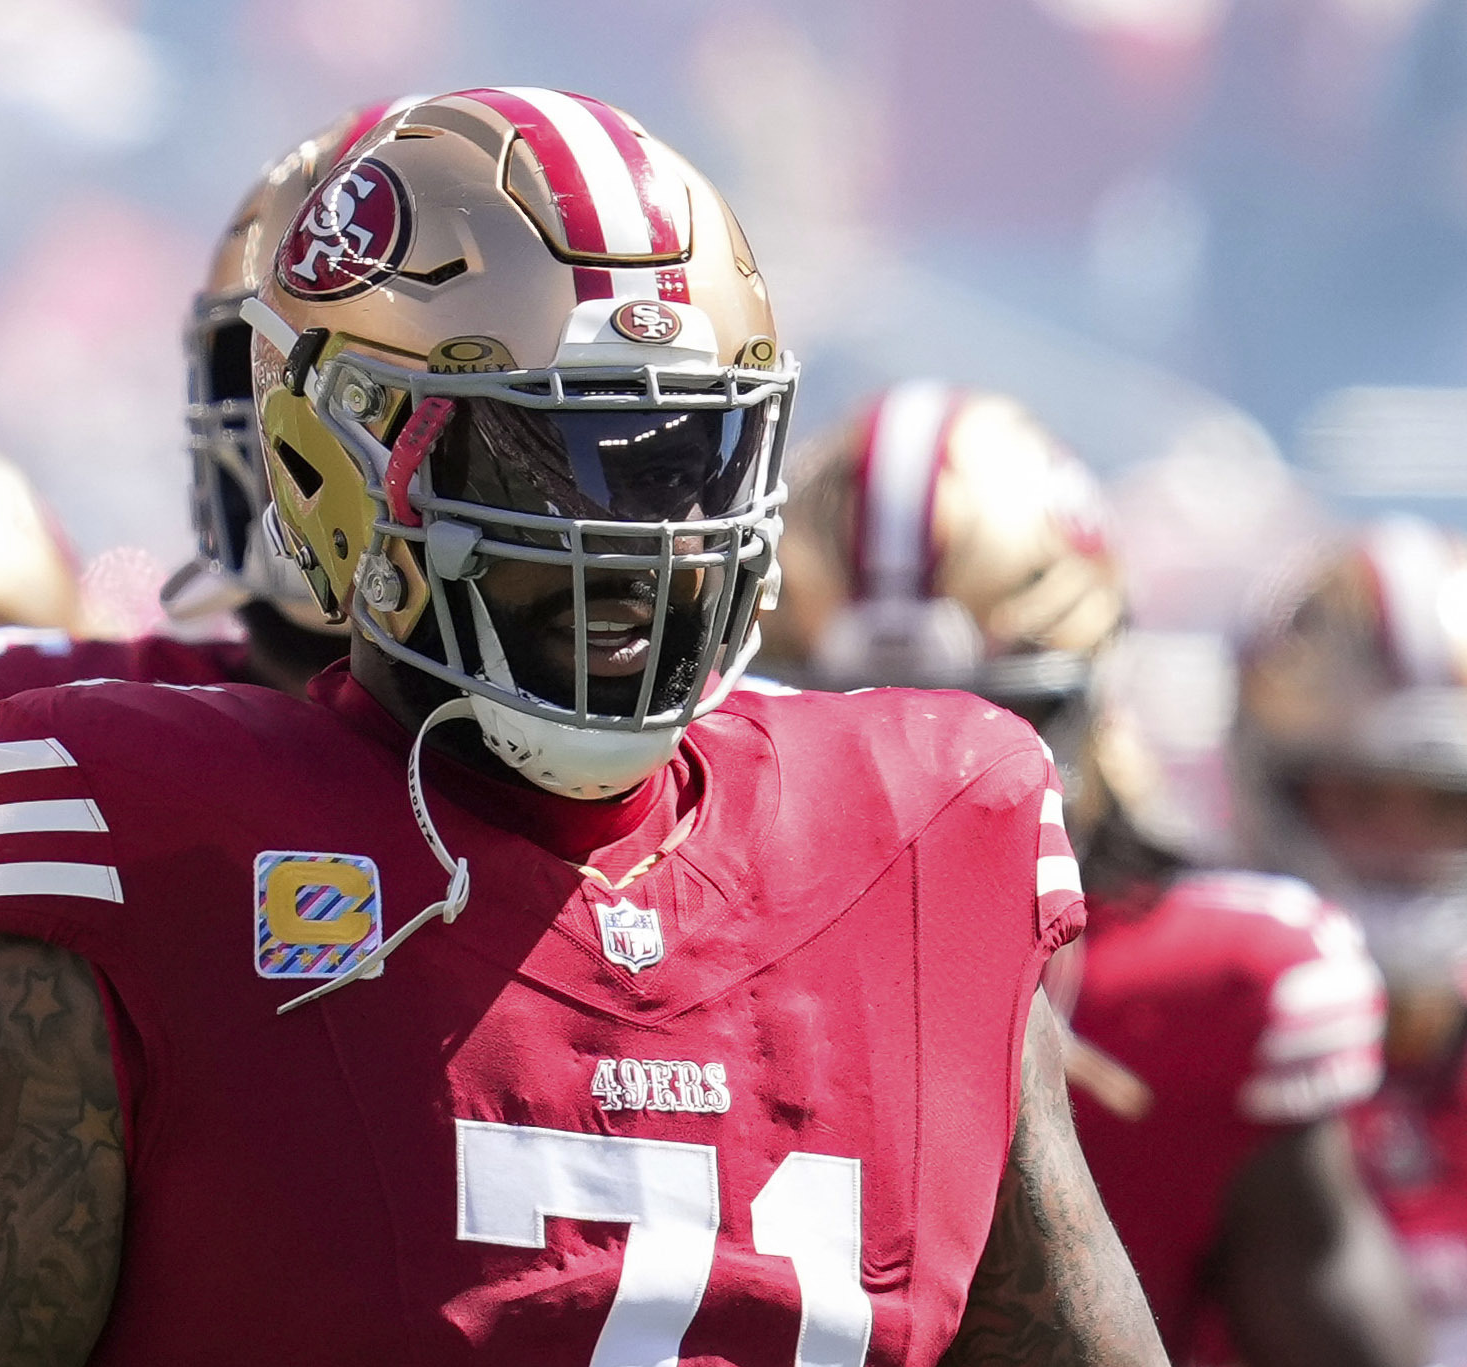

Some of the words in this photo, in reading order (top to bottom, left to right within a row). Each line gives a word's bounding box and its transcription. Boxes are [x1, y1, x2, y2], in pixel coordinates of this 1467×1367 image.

[632, 303, 674, 339] SF
[267, 860, 372, 945] C
[592, 1058, 732, 1114] 49ERS
